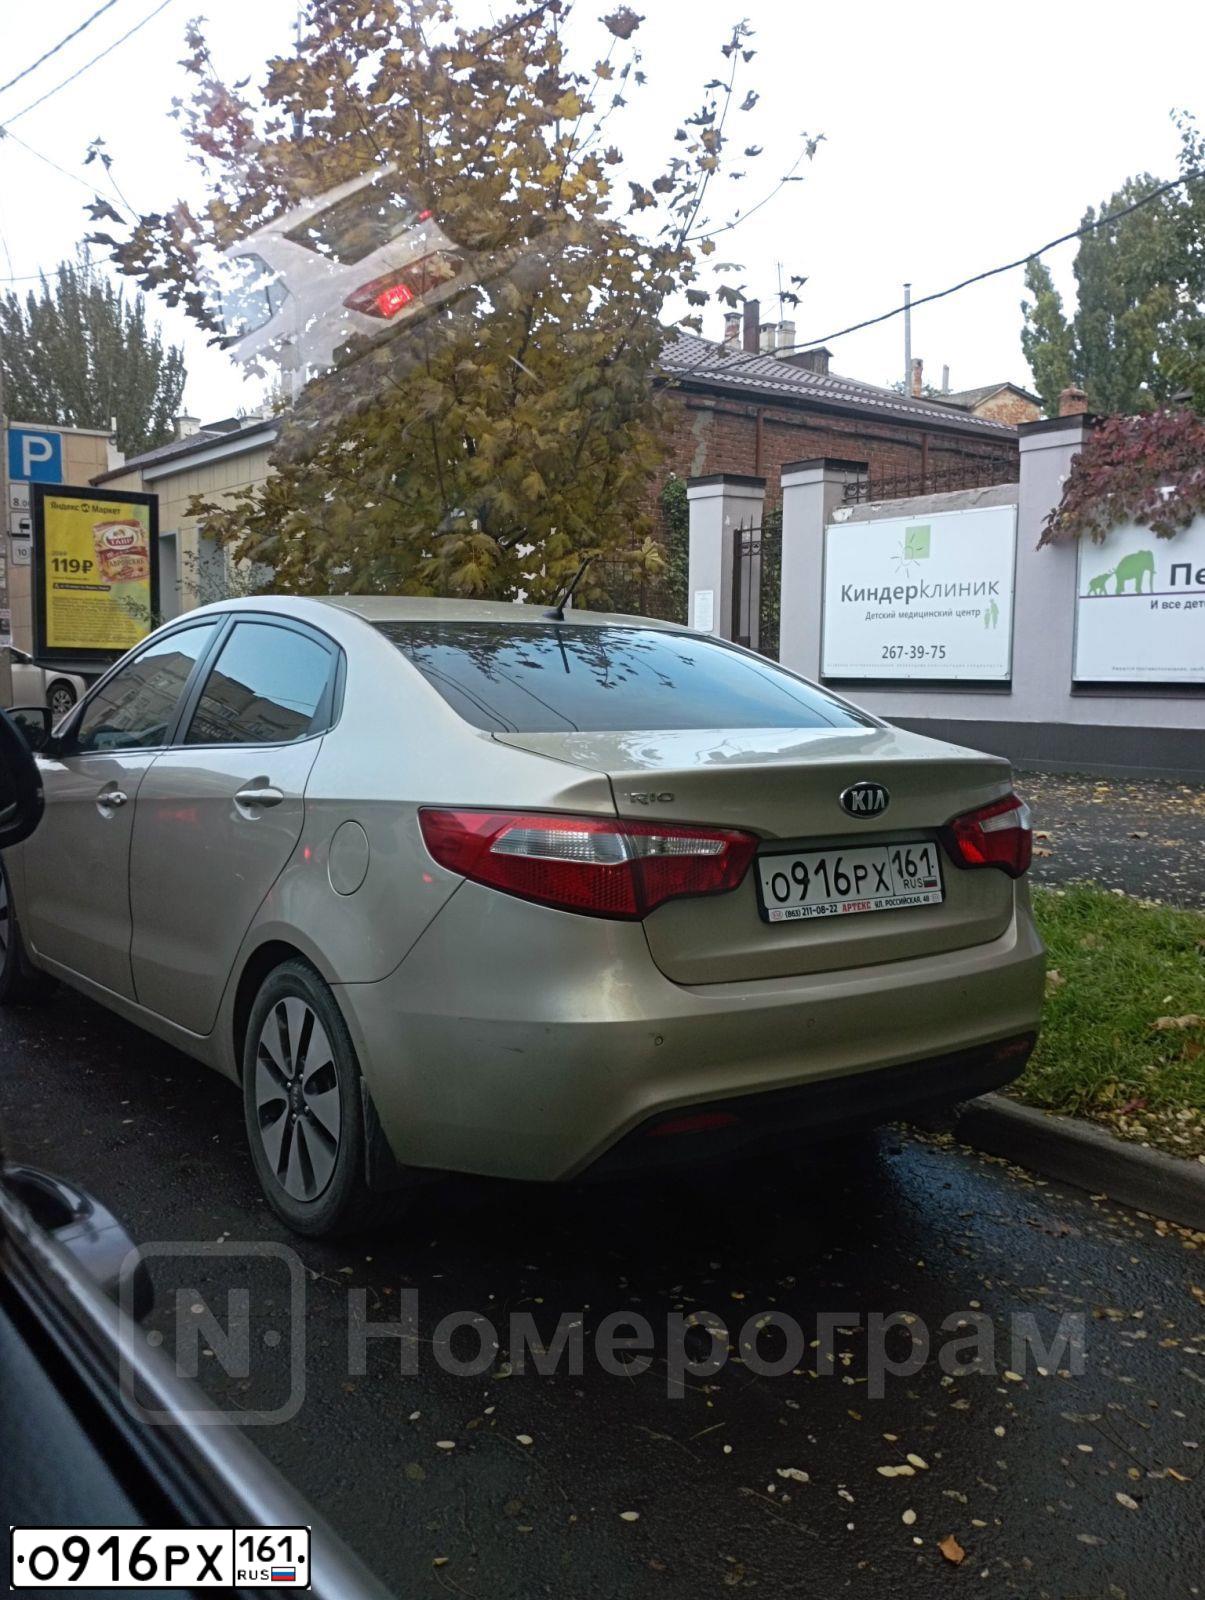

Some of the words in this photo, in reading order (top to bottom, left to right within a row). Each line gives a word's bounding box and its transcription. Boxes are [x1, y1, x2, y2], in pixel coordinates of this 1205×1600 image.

[22, 435, 53, 476] P
[92, 505, 121, 515] Маркет
[1150, 600, 1158, 609] И
[1162, 600, 1181, 609] все
[1184, 600, 1205, 610] дет
[865, 610, 896, 621] Детский
[898, 608, 953, 620] медицинский
[955, 608, 981, 619] центр
[881, 645, 947, 660] 267-39-75
[851, 789, 885, 811] KIA
[892, 848, 932, 878] 161
[903, 877, 923, 889] RUS
[785, 909, 801, 918] (863)
[802, 904, 838, 916] 211-08-22
[842, 900, 872, 912] АРТЕКС
